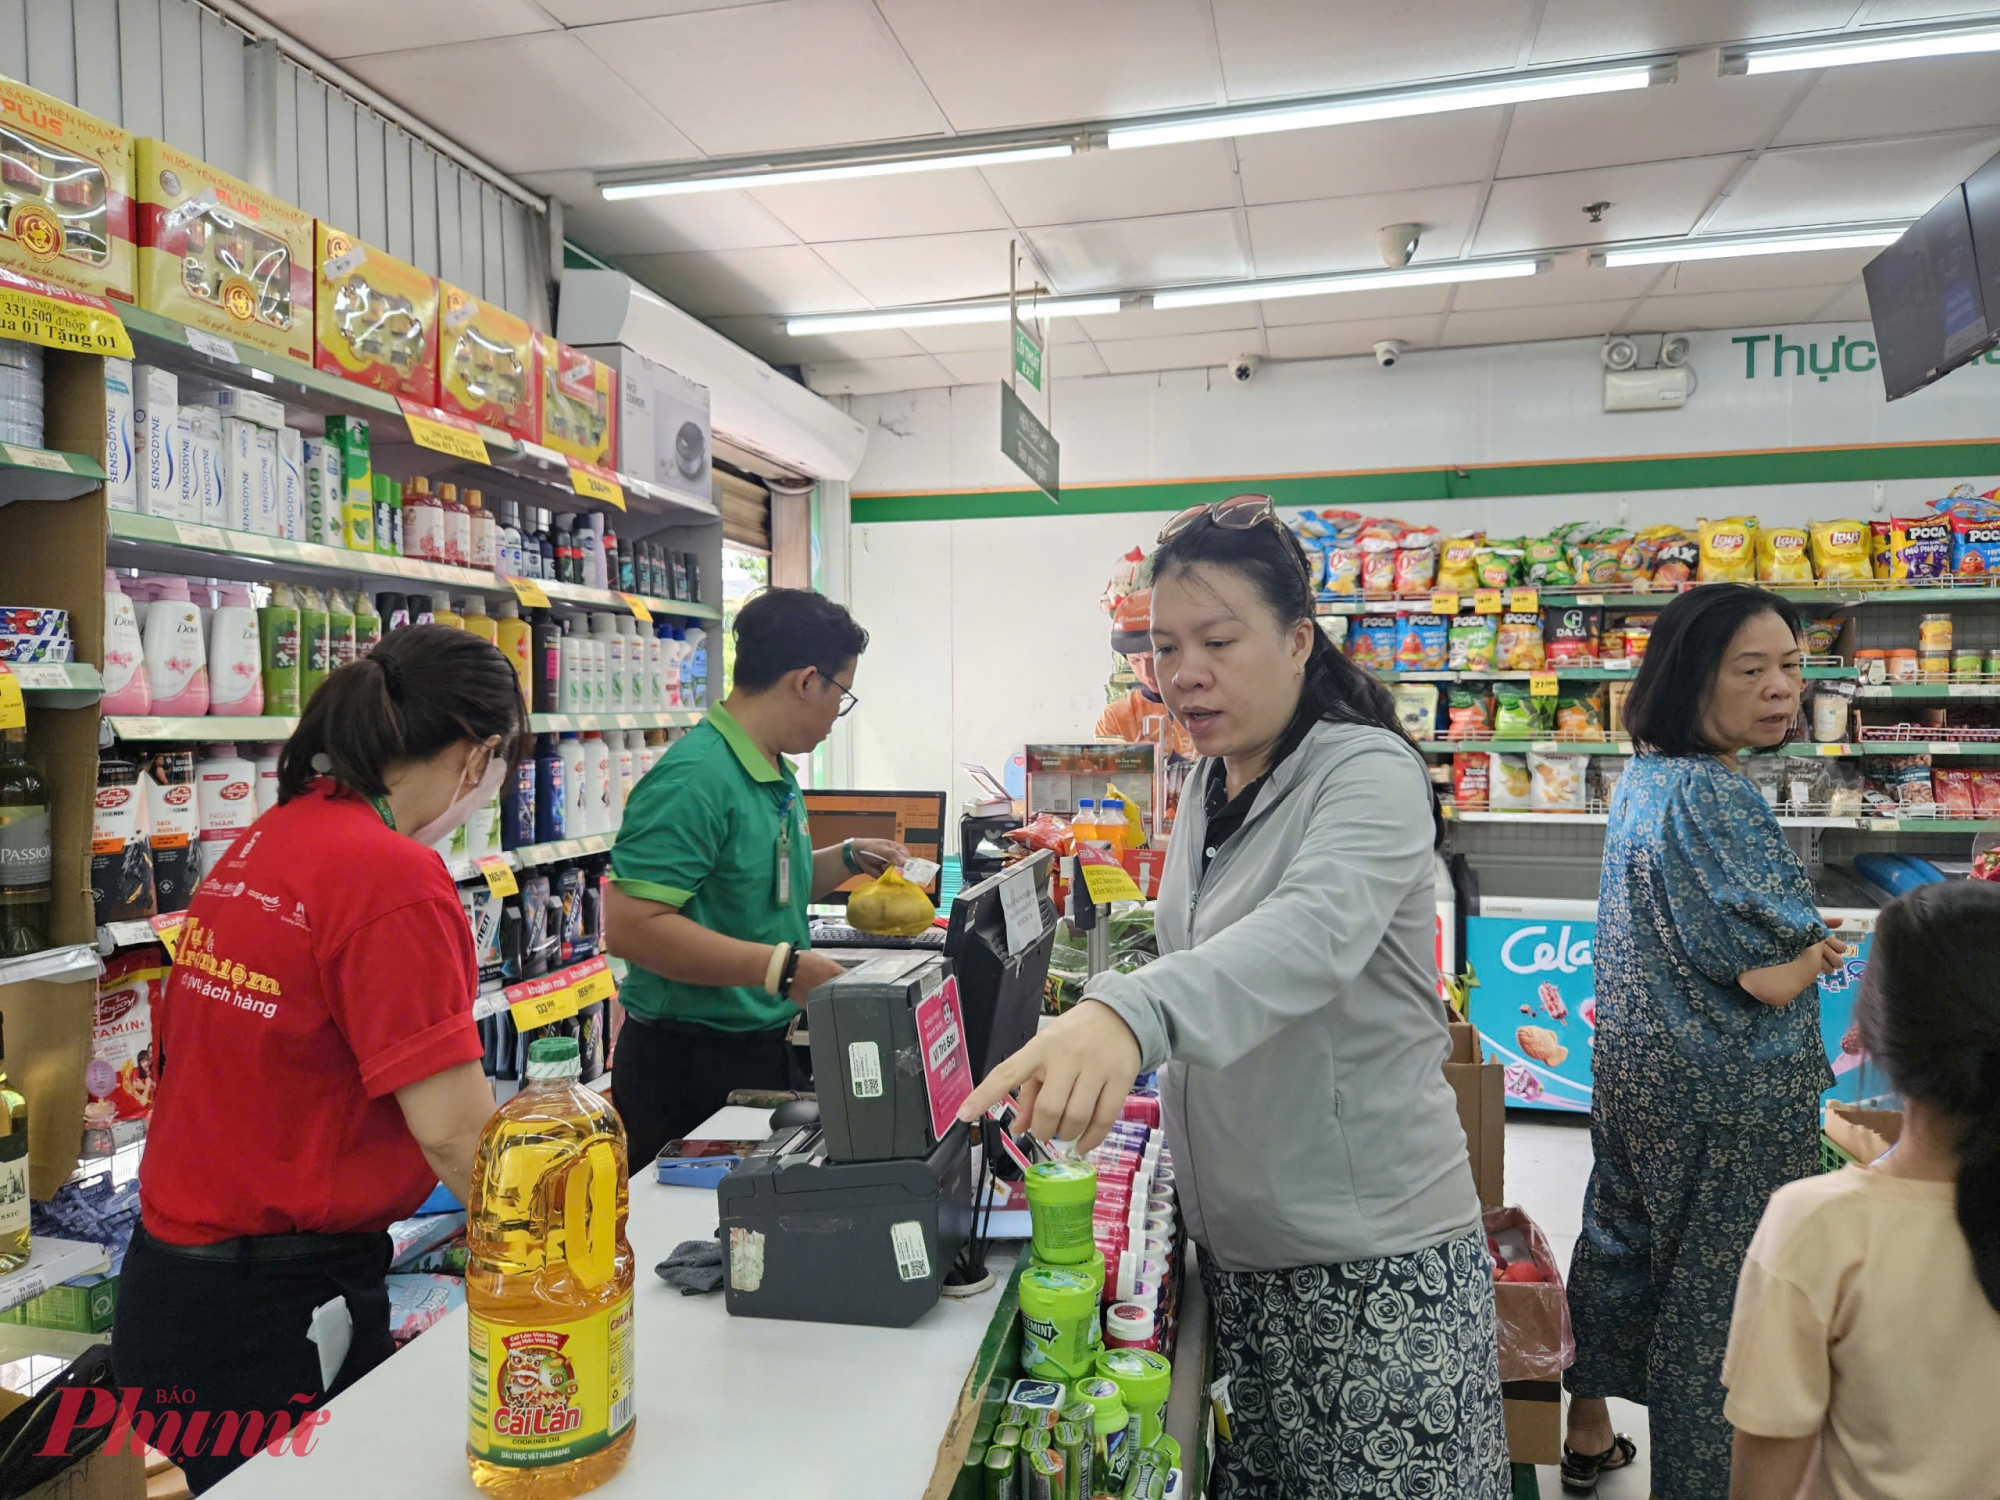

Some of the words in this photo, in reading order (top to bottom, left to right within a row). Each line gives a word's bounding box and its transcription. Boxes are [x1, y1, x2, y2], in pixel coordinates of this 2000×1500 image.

[1, 97, 63, 136] PLUS
[215, 188, 260, 220] PLUS
[5, 302, 52, 323] 331.500
[56, 317, 86, 332] đ/hộp
[22, 323, 39, 335] 01
[45, 325, 92, 348] Tặng
[97, 335, 117, 349] 01
[1022, 361, 1035, 382] EXIT
[1732, 334, 1877, 383] Thực
[107, 406, 119, 484] SENSODYNE
[151, 416, 161, 491] SENSODYNE
[182, 438, 191, 500] SENSODYNE
[204, 449, 213, 507] SENSODYNE
[242, 471, 250, 532] SENSODYNE
[1909, 526, 1947, 540] POCA
[1968, 529, 2000, 543] POC
[114, 615, 136, 626] Dove
[177, 623, 200, 634] Dove
[1363, 617, 1395, 628] POCA
[1409, 615, 1441, 625] POCA
[1453, 615, 1485, 627] POCA
[1504, 613, 1537, 624] POCA
[1501, 926, 1594, 975] Cela
[202, 980, 231, 1003] ách
[233, 991, 278, 1019] hàng
[940, 1056, 956, 1082] momo
[494, 1406, 533, 1437] Cái
[533, 1404, 581, 1436] Lân
